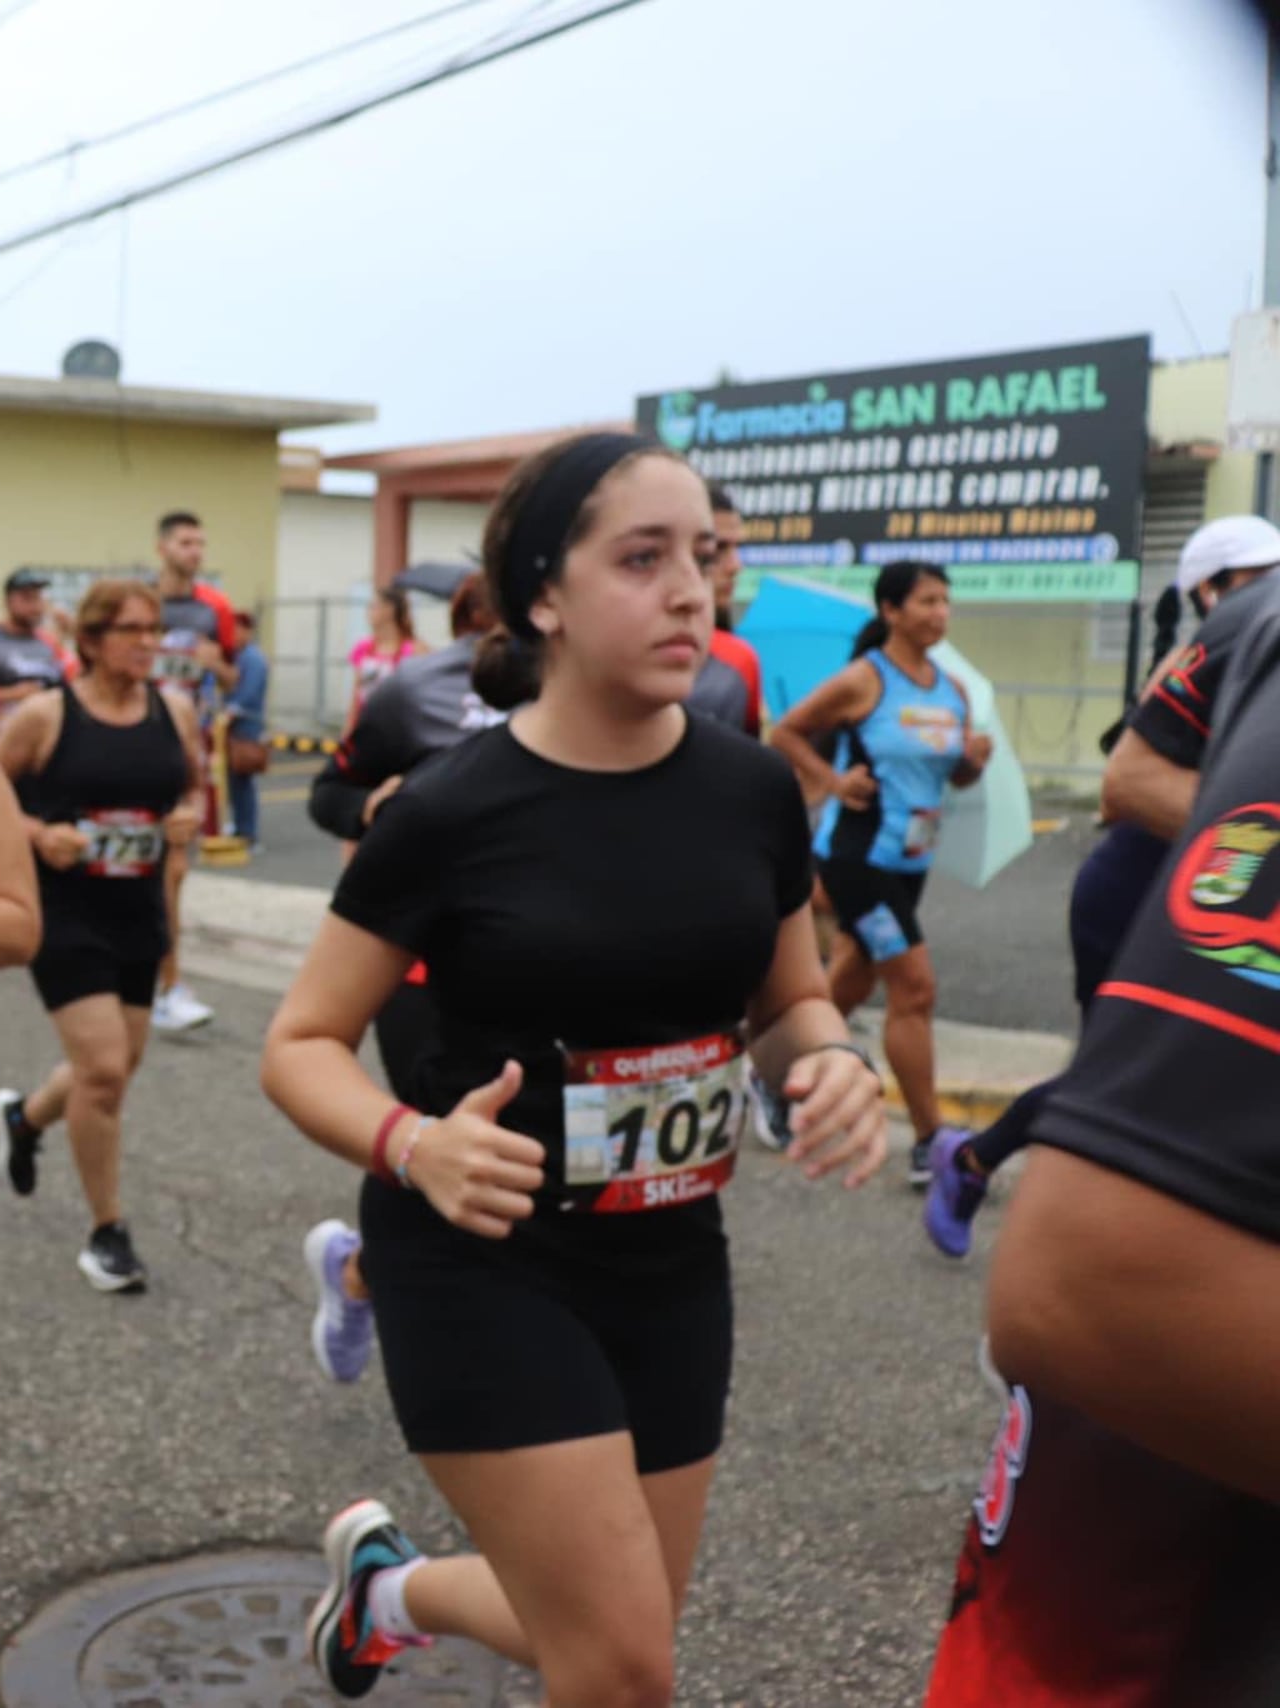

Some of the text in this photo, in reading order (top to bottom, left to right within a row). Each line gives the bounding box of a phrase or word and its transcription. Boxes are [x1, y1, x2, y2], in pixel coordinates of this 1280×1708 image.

[696, 364, 1107, 444] Farmacia SAN RAFAEL
[907, 422, 1059, 467] exclusivo
[818, 470, 954, 512] MIENTRAS
[607, 1088, 732, 1173] 102
